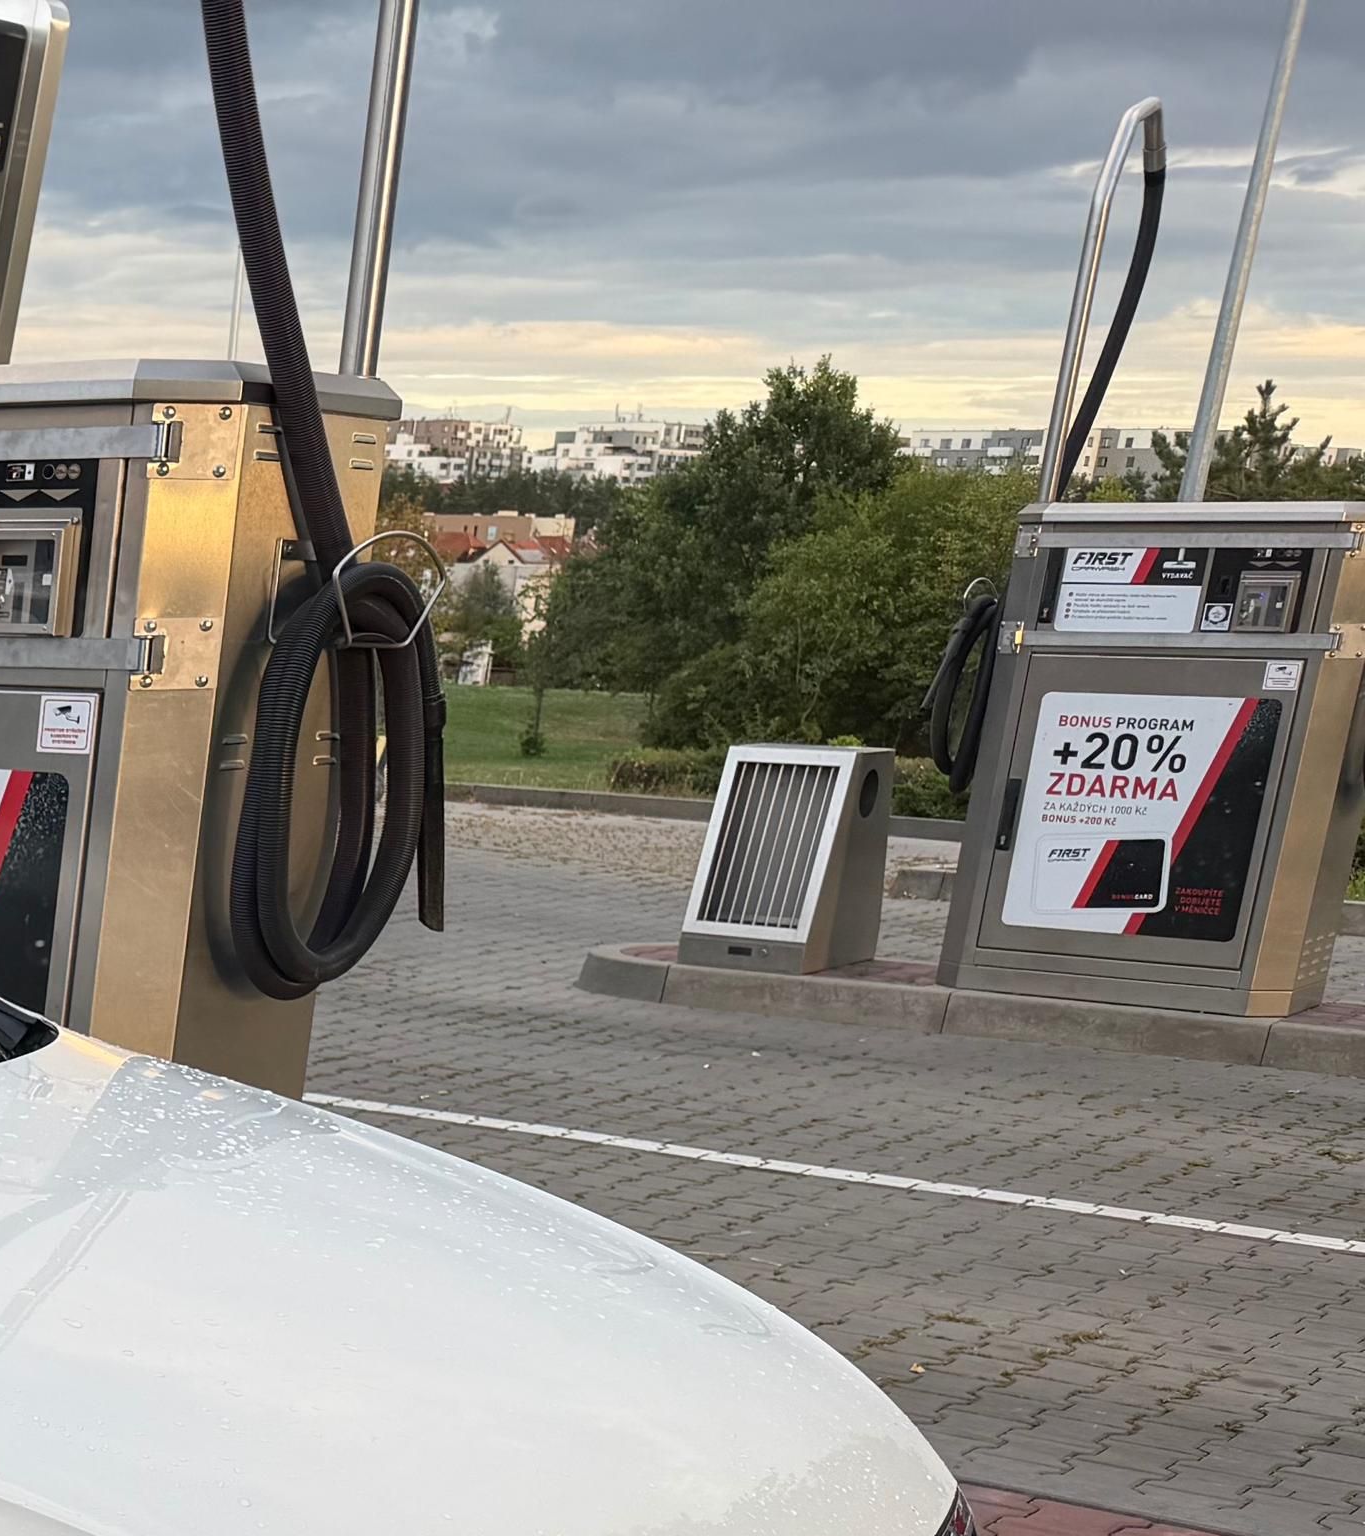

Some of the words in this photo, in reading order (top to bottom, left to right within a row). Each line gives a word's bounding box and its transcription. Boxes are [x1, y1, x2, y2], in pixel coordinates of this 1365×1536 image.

[1058, 715, 1112, 728] BONUS
[1116, 717, 1194, 732] PROGRAM
[1053, 732, 1187, 774] +20%
[1046, 772, 1179, 802] ZDARMA
[1043, 801, 1057, 811] ZA
[1059, 802, 1106, 814] KAŽDÝCH
[1110, 805, 1133, 815] 1000
[1135, 806, 1148, 816] Kč
[1041, 814, 1076, 824] BONUS
[1078, 816, 1102, 825] +200
[1104, 816, 1117, 826] Kč
